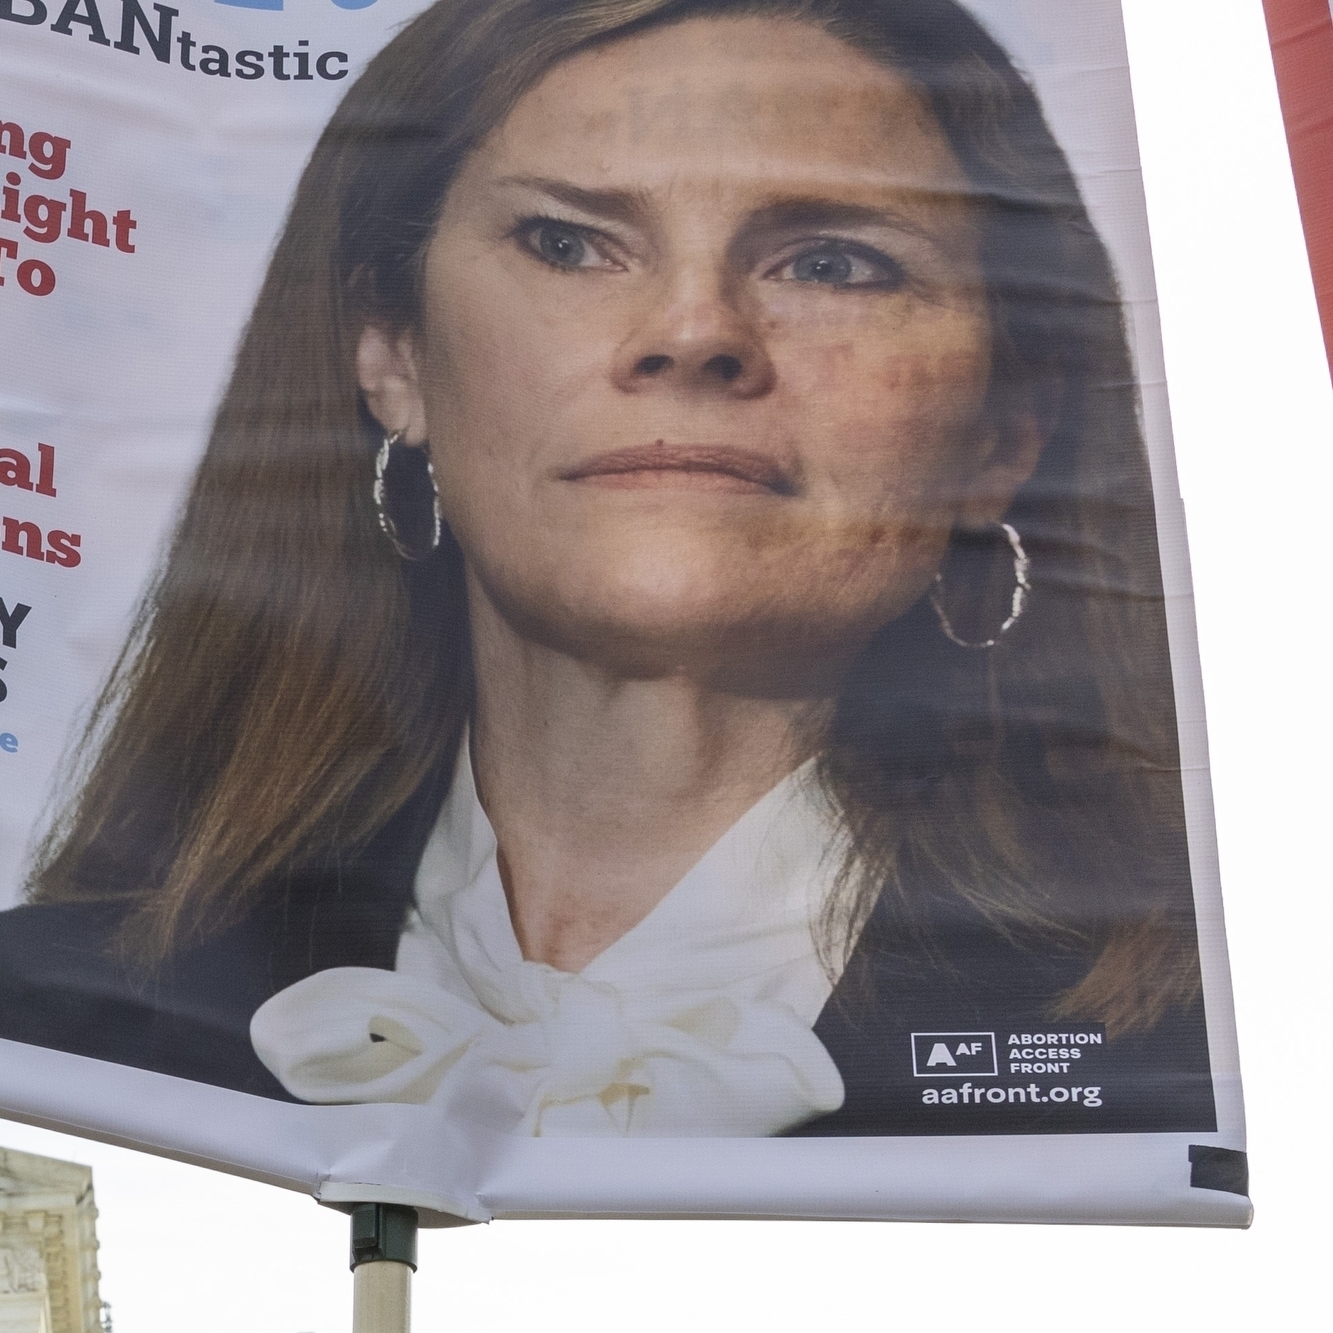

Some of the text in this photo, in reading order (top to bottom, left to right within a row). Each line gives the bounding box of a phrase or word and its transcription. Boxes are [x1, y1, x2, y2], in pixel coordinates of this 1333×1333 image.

[1007, 1033, 1102, 1045] ABORTION
[1009, 1048, 1081, 1059] ACCESS
[1010, 1062, 1070, 1074] FRONT
[922, 1082, 1103, 1107] aafront.org
